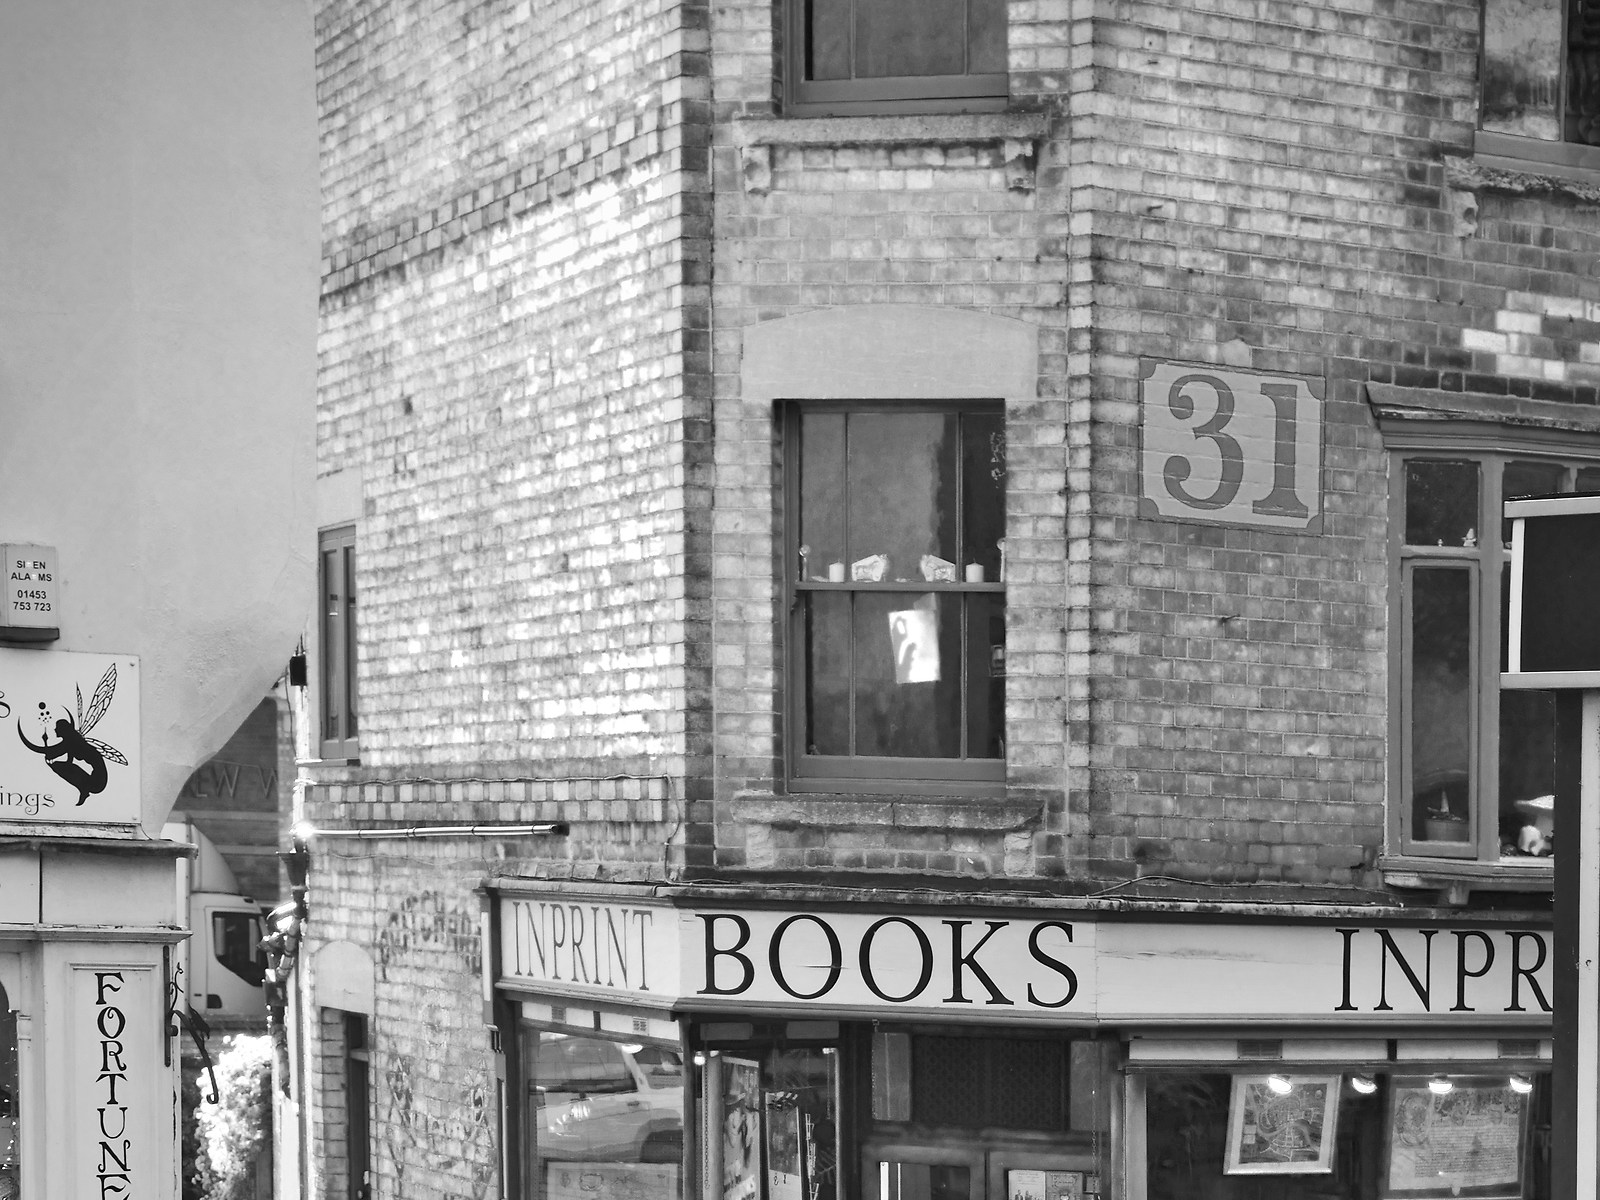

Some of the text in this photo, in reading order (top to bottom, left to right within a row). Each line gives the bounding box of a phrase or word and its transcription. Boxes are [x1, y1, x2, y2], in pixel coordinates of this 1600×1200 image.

[1163, 373, 1308, 518] 31
[13, 601, 51, 612] 753 723
[17, 589, 47, 600] 01453
[512, 901, 653, 992] INPRINT
[696, 913, 1079, 1008] BOOKS
[1334, 928, 1553, 1012] INPR
